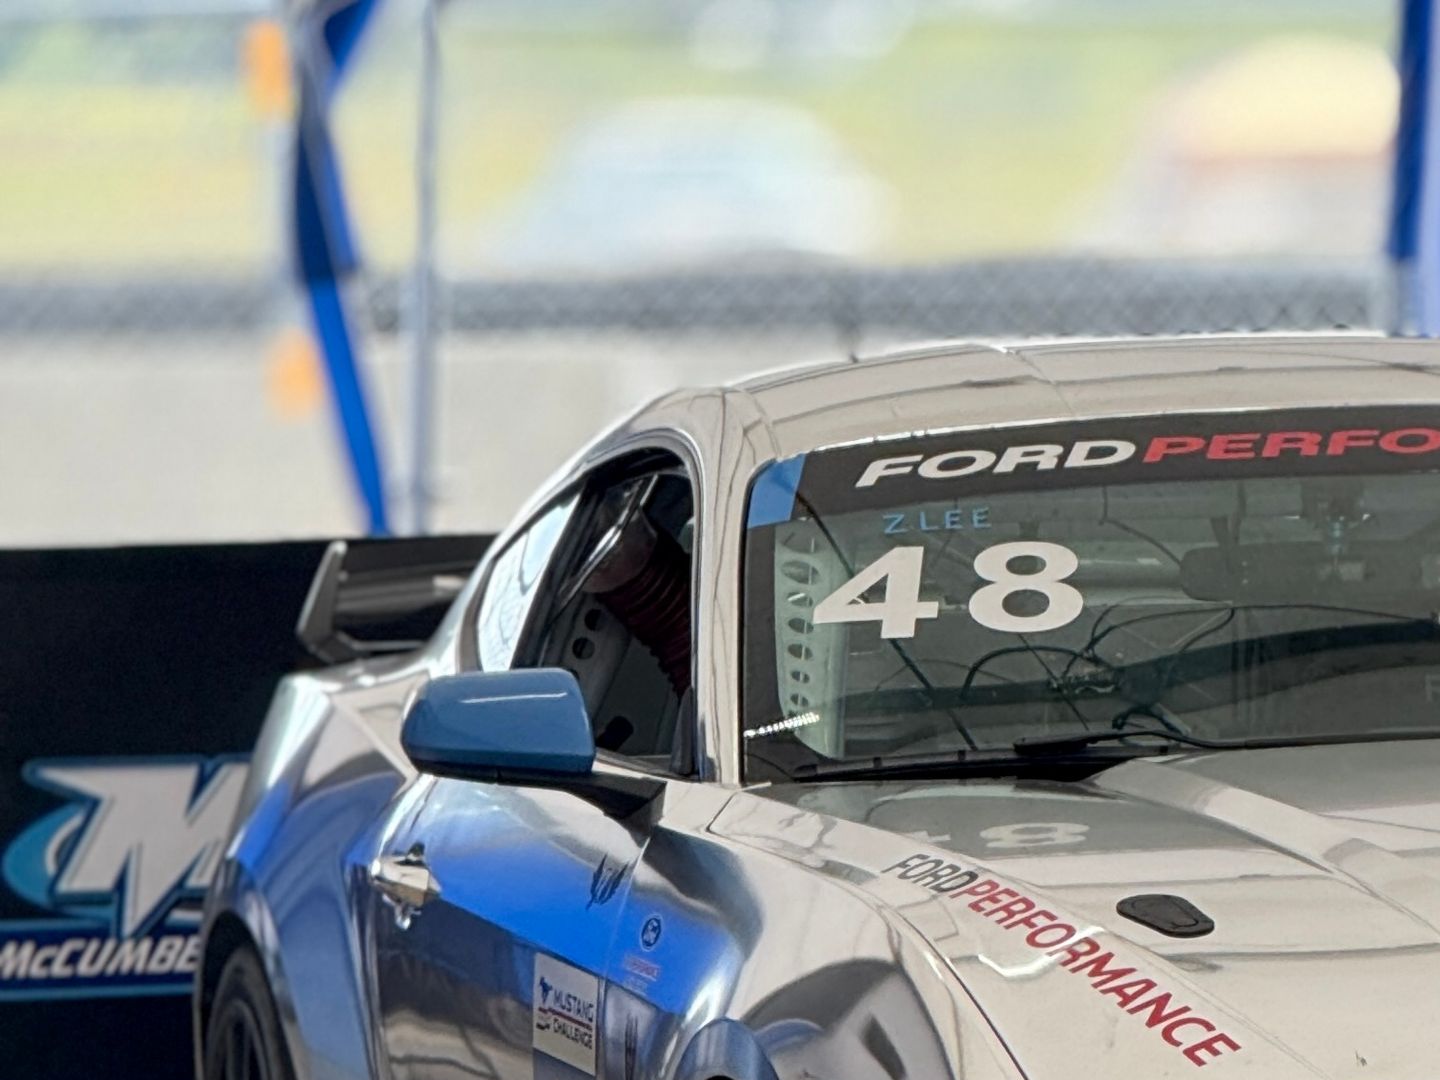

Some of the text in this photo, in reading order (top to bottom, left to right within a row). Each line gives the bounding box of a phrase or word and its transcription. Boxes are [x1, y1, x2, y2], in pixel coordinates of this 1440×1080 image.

[882, 505, 993, 534] Z LEE
[812, 541, 1084, 639] 48
[554, 987, 594, 1023] MUSTANG
